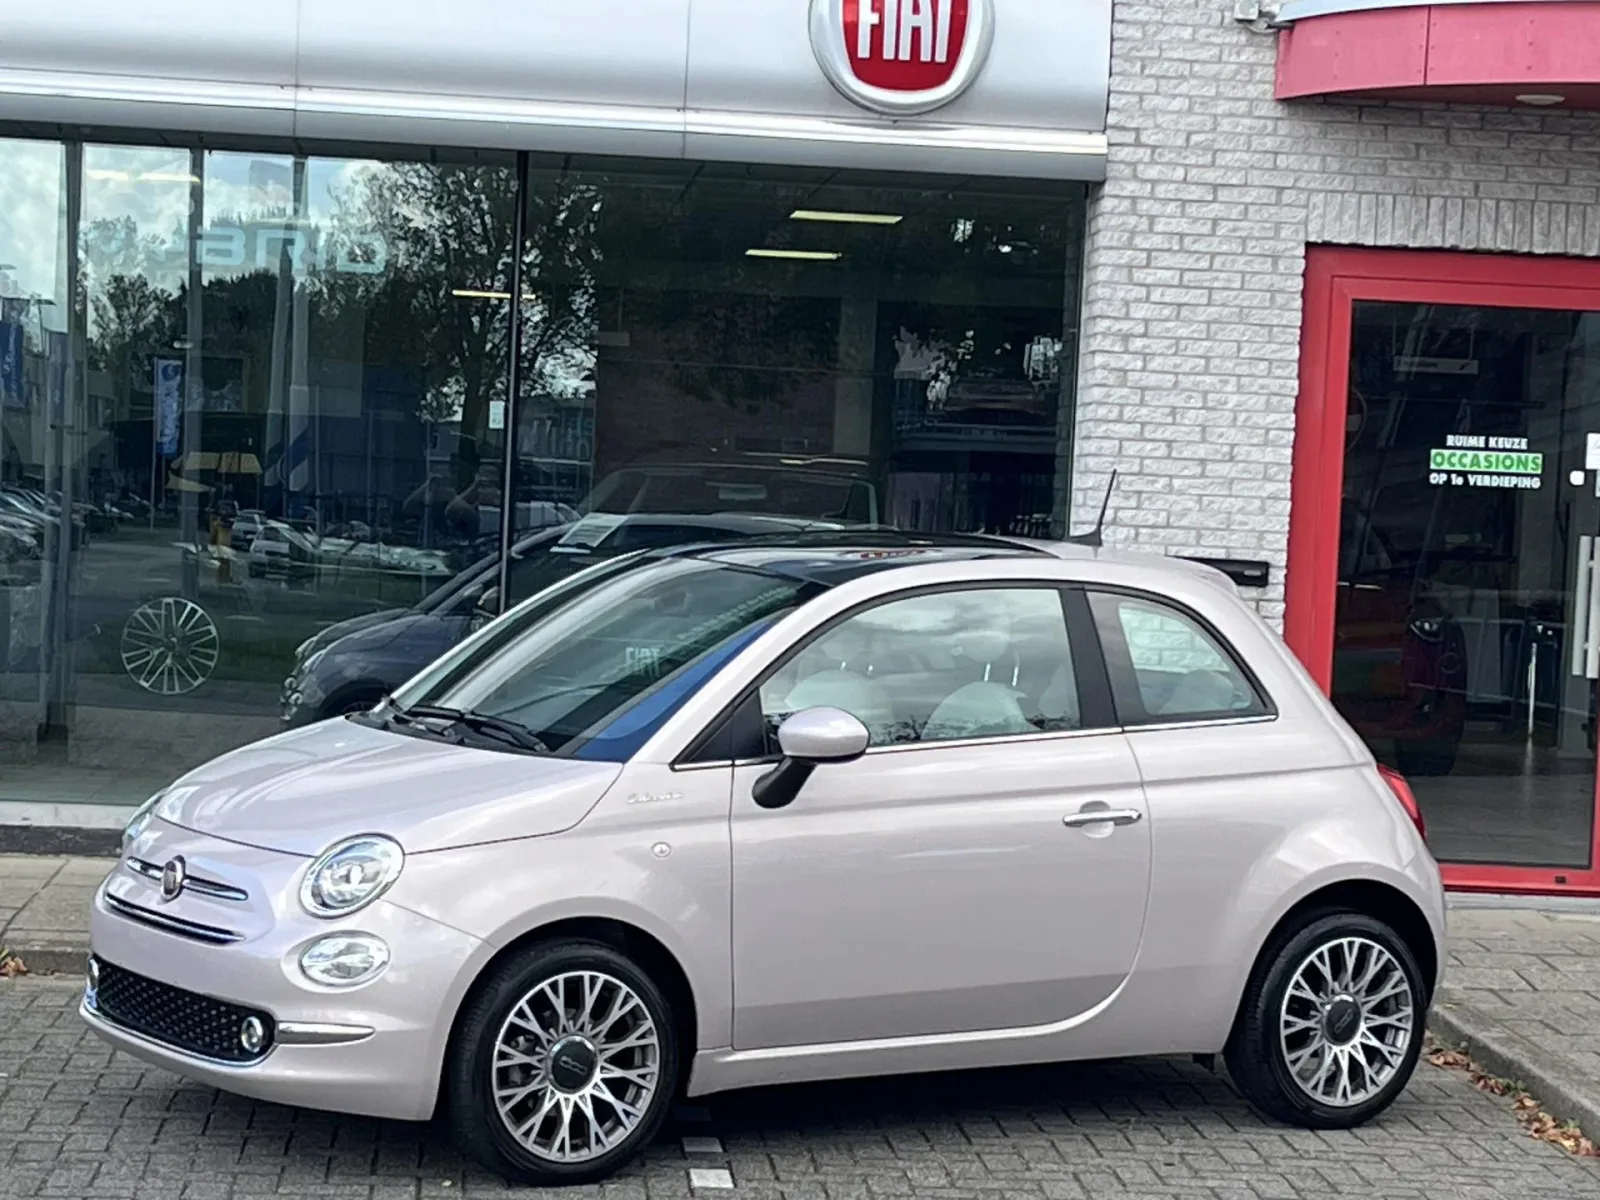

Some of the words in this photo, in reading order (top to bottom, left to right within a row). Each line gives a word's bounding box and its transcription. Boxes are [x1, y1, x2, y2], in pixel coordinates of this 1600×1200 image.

[857, 0, 952, 63] FIAT
[1446, 434, 1486, 448] RUIME
[1488, 436, 1528, 450] KEUZE
[1432, 451, 1541, 471] OCCASIONS
[1429, 472, 1448, 485] OP
[1467, 473, 1541, 489] VERDIEPING
